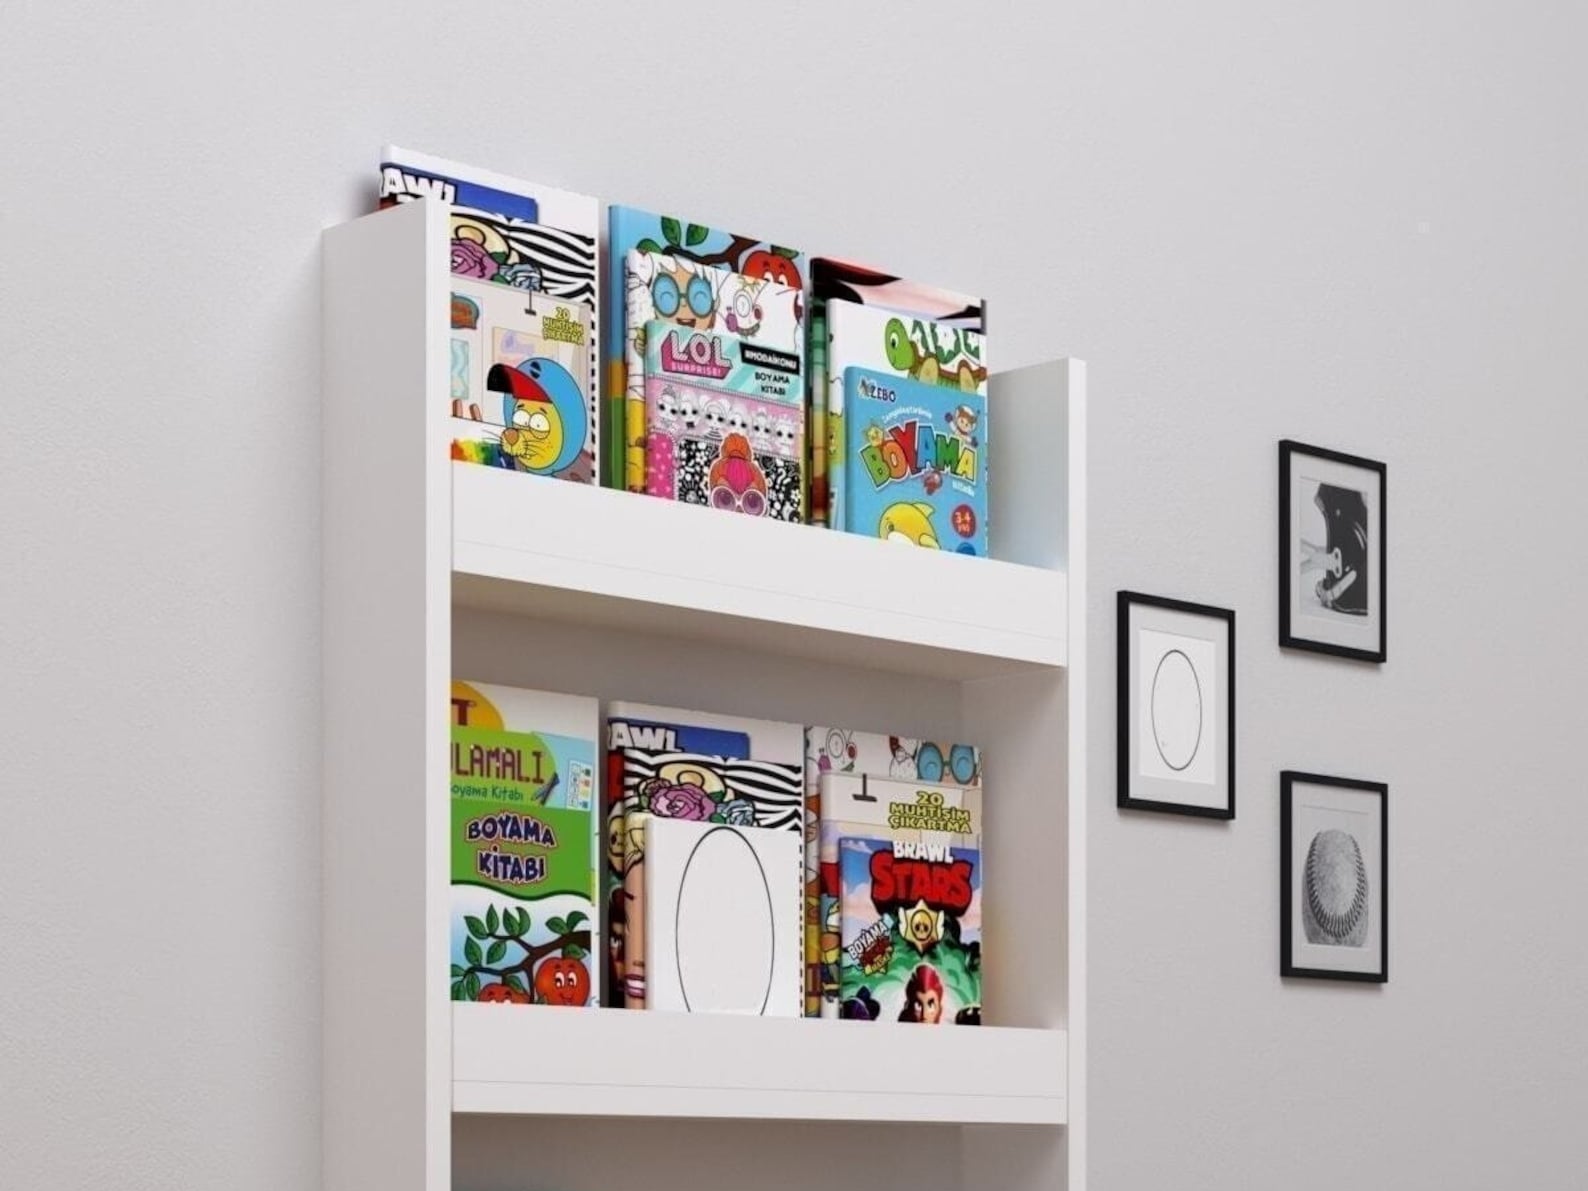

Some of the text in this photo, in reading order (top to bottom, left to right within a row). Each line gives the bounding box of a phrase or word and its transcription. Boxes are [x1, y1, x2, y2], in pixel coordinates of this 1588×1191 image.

[669, 330, 733, 368] LOL
[860, 420, 976, 489] BOYAMA
[450, 742, 545, 785] LAMALI
[915, 791, 944, 806] 20
[467, 814, 555, 846] BOYAMA
[893, 840, 954, 864] BRAWL
[870, 850, 973, 908] STARS
